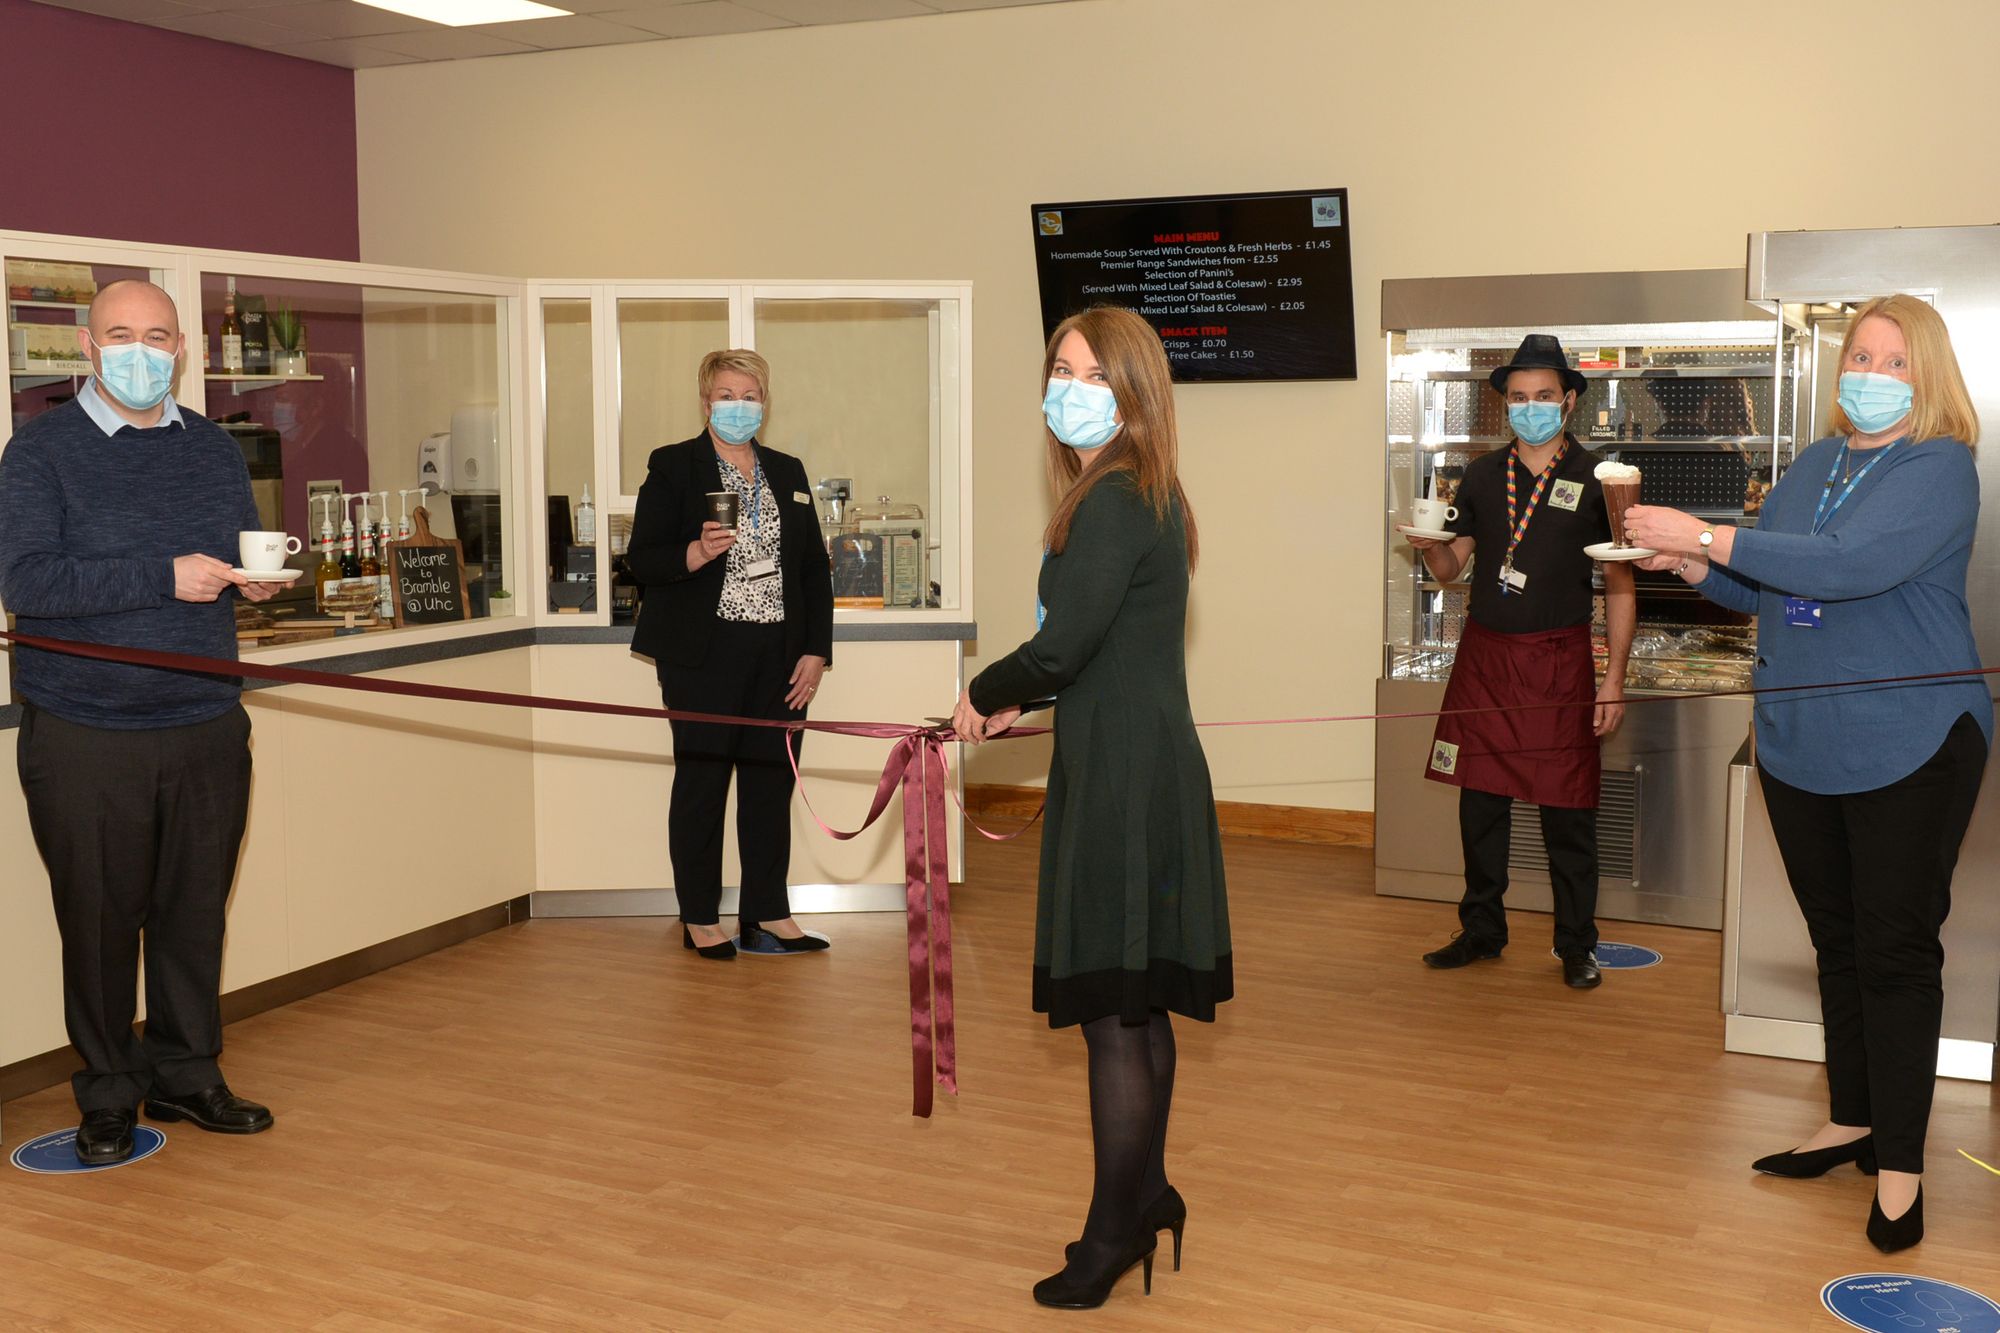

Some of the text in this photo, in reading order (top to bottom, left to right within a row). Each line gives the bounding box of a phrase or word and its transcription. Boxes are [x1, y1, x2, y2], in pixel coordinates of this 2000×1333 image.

[1154, 232, 1219, 243] MAIN MENU
[1051, 250, 1102, 260] Homemade
[1104, 249, 1127, 259] Soup
[1129, 247, 1160, 257] Served
[1161, 246, 1182, 255] With
[1185, 245, 1227, 254] Croutons
[1229, 244, 1236, 253] &
[1237, 243, 1263, 252] Fresh
[1264, 242, 1293, 251] Herbs
[1305, 240, 1331, 250] £1.45
[1101, 260, 1134, 269] Premier
[1137, 259, 1165, 269] Range
[1167, 257, 1221, 267] Sandwiches
[1223, 256, 1245, 265] from
[1253, 255, 1279, 264] £2.55
[1145, 268, 1234, 279] Selection of Panini's
[1082, 284, 1115, 294] (Served
[1117, 283, 1138, 292] With
[1140, 282, 1167, 291] Mixed
[1169, 281, 1188, 291] Leaf
[1190, 281, 1214, 290] Salad
[1216, 280, 1224, 289] &
[1225, 279, 1267, 289] Colesaw)
[1277, 278, 1302, 287] £2.95
[1144, 292, 1236, 303] Selection Of Toasties
[1140, 305, 1168, 314] Mixed
[1169, 305, 1189, 314] Leaf
[1190, 304, 1215, 313] Salad
[1217, 304, 1224, 312] &
[1225, 303, 1267, 313] Colesaw)
[1280, 302, 1305, 311] £2.05
[1161, 327, 1227, 336] SNACK ITEM
[1163, 340, 1190, 350] Crisps
[1202, 339, 1227, 348] £0.70
[1170, 351, 1189, 360] Free
[1191, 350, 1218, 360] Cakes
[1230, 350, 1254, 359] £1.50
[398, 547, 450, 569] Welcome
[421, 569, 432, 578] to
[400, 577, 451, 595] Bramble
[407, 598, 422, 613] @
[1847, 1282, 1881, 1291] Please
